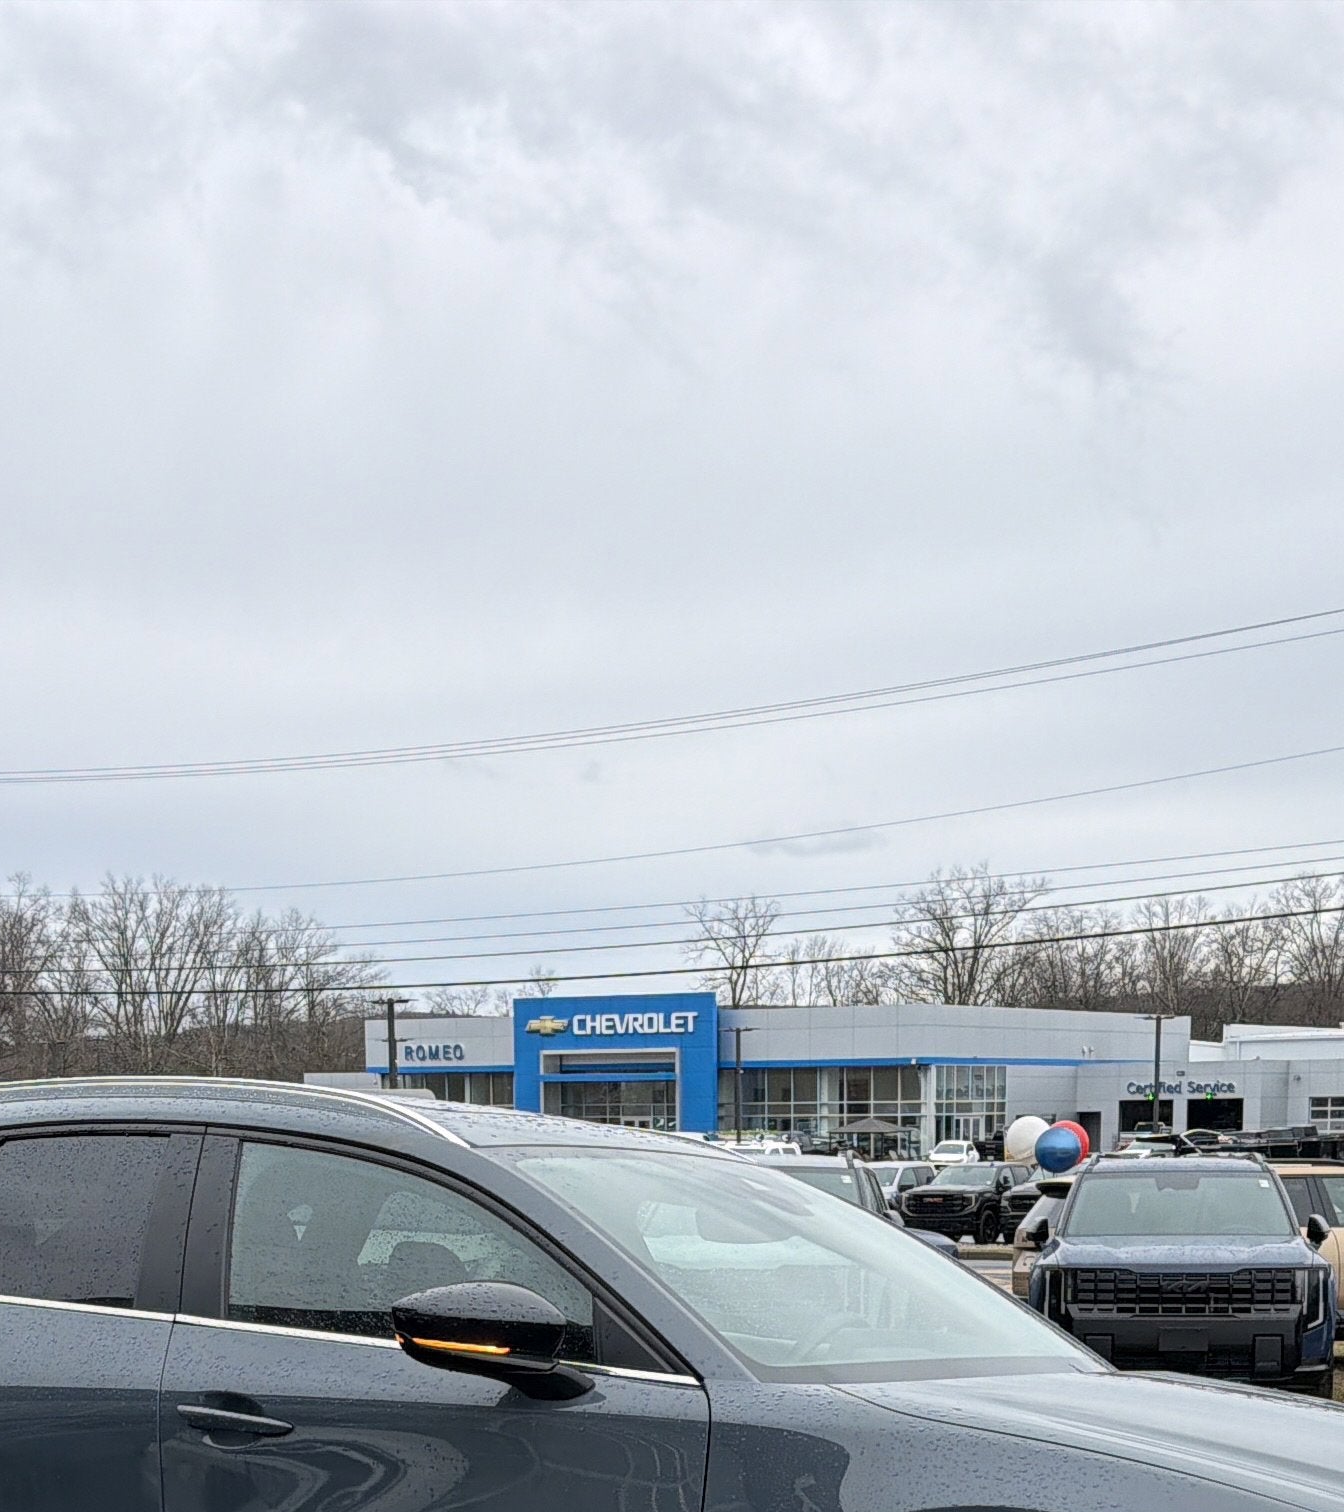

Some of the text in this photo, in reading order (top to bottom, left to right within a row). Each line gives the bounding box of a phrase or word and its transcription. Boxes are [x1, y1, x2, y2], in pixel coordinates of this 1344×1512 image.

[572, 1011, 699, 1036] CHEVROLET
[403, 1043, 465, 1062] ROMEO
[1126, 1080, 1237, 1097] Certfied Service
